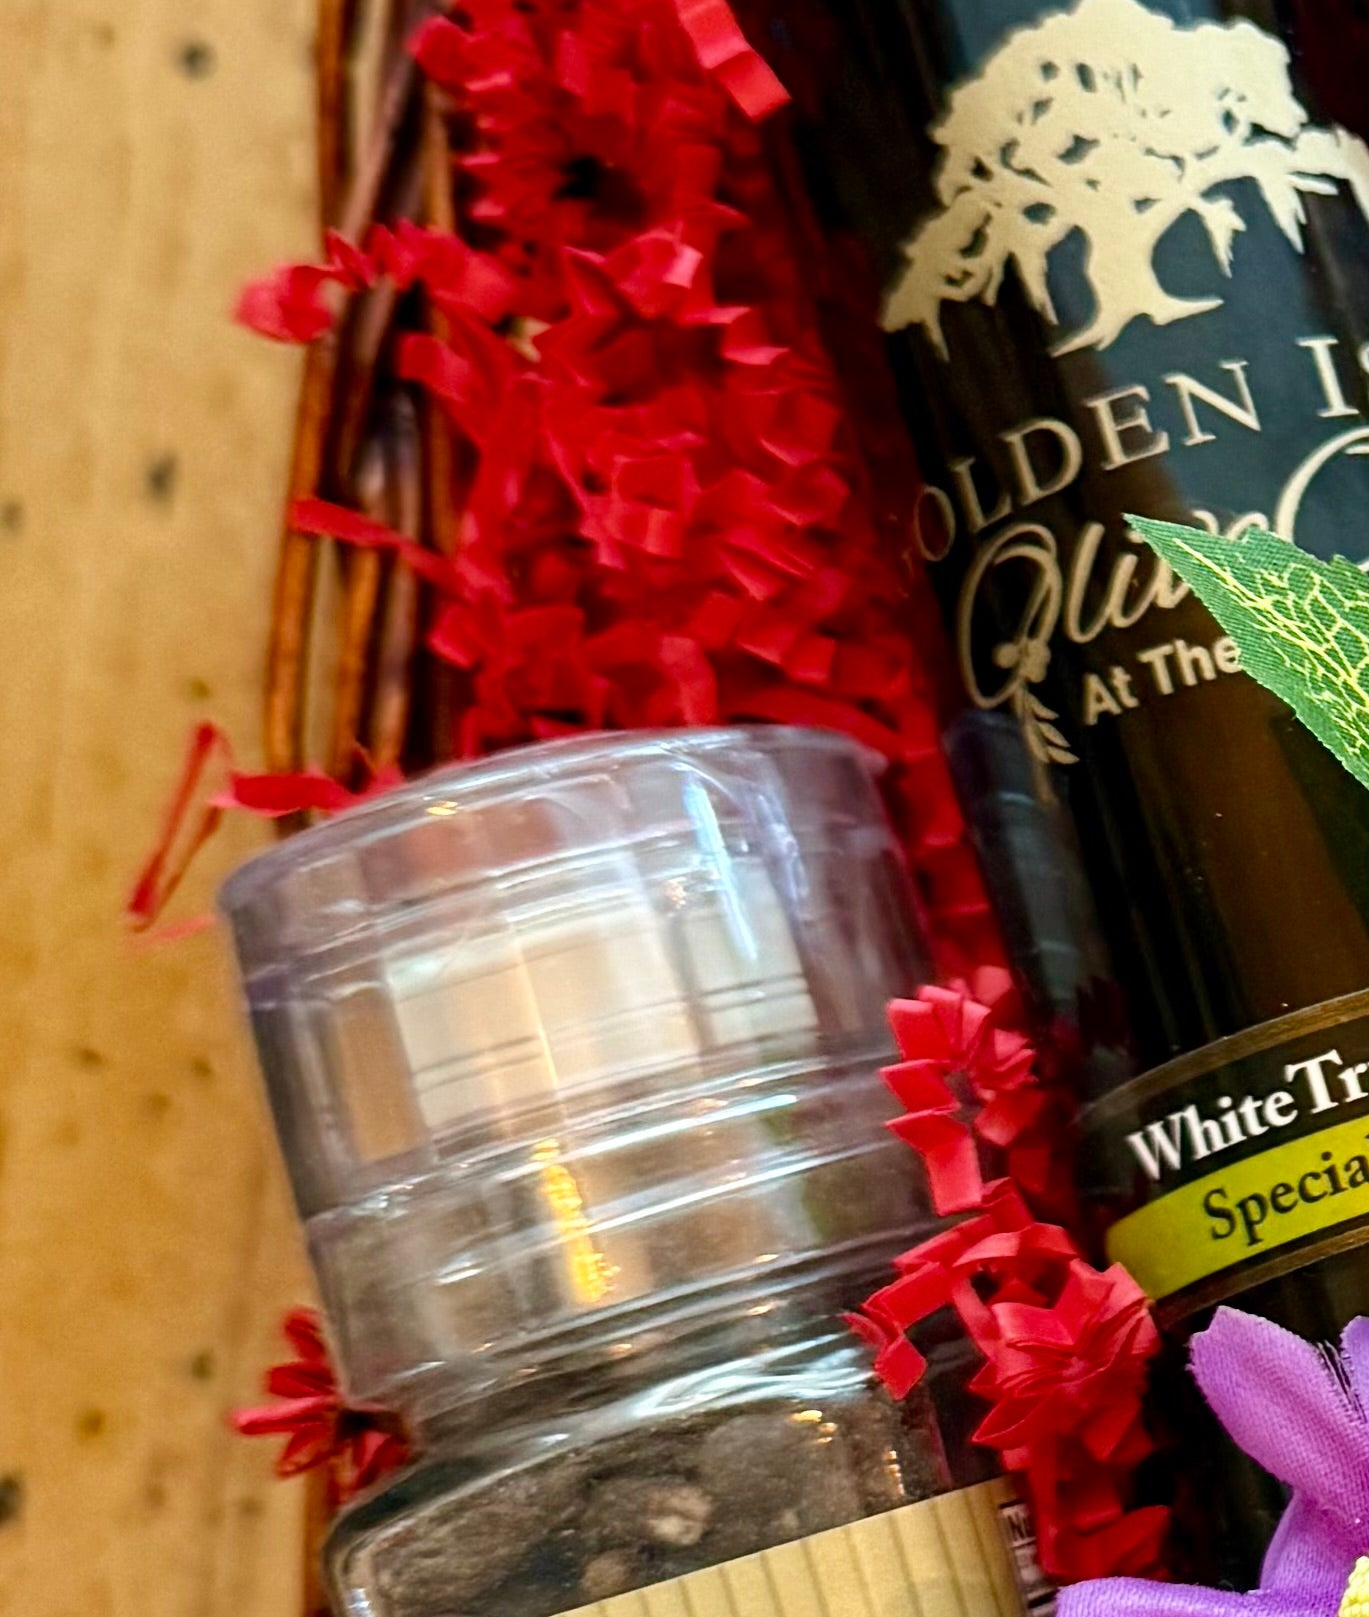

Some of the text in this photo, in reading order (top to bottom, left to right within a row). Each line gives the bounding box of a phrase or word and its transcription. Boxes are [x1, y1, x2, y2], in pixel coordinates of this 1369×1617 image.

[913, 360, 1263, 562] OLDEN
[1083, 665, 1139, 726] At
[1137, 636, 1241, 696] The
[1124, 1088, 1300, 1182] White
